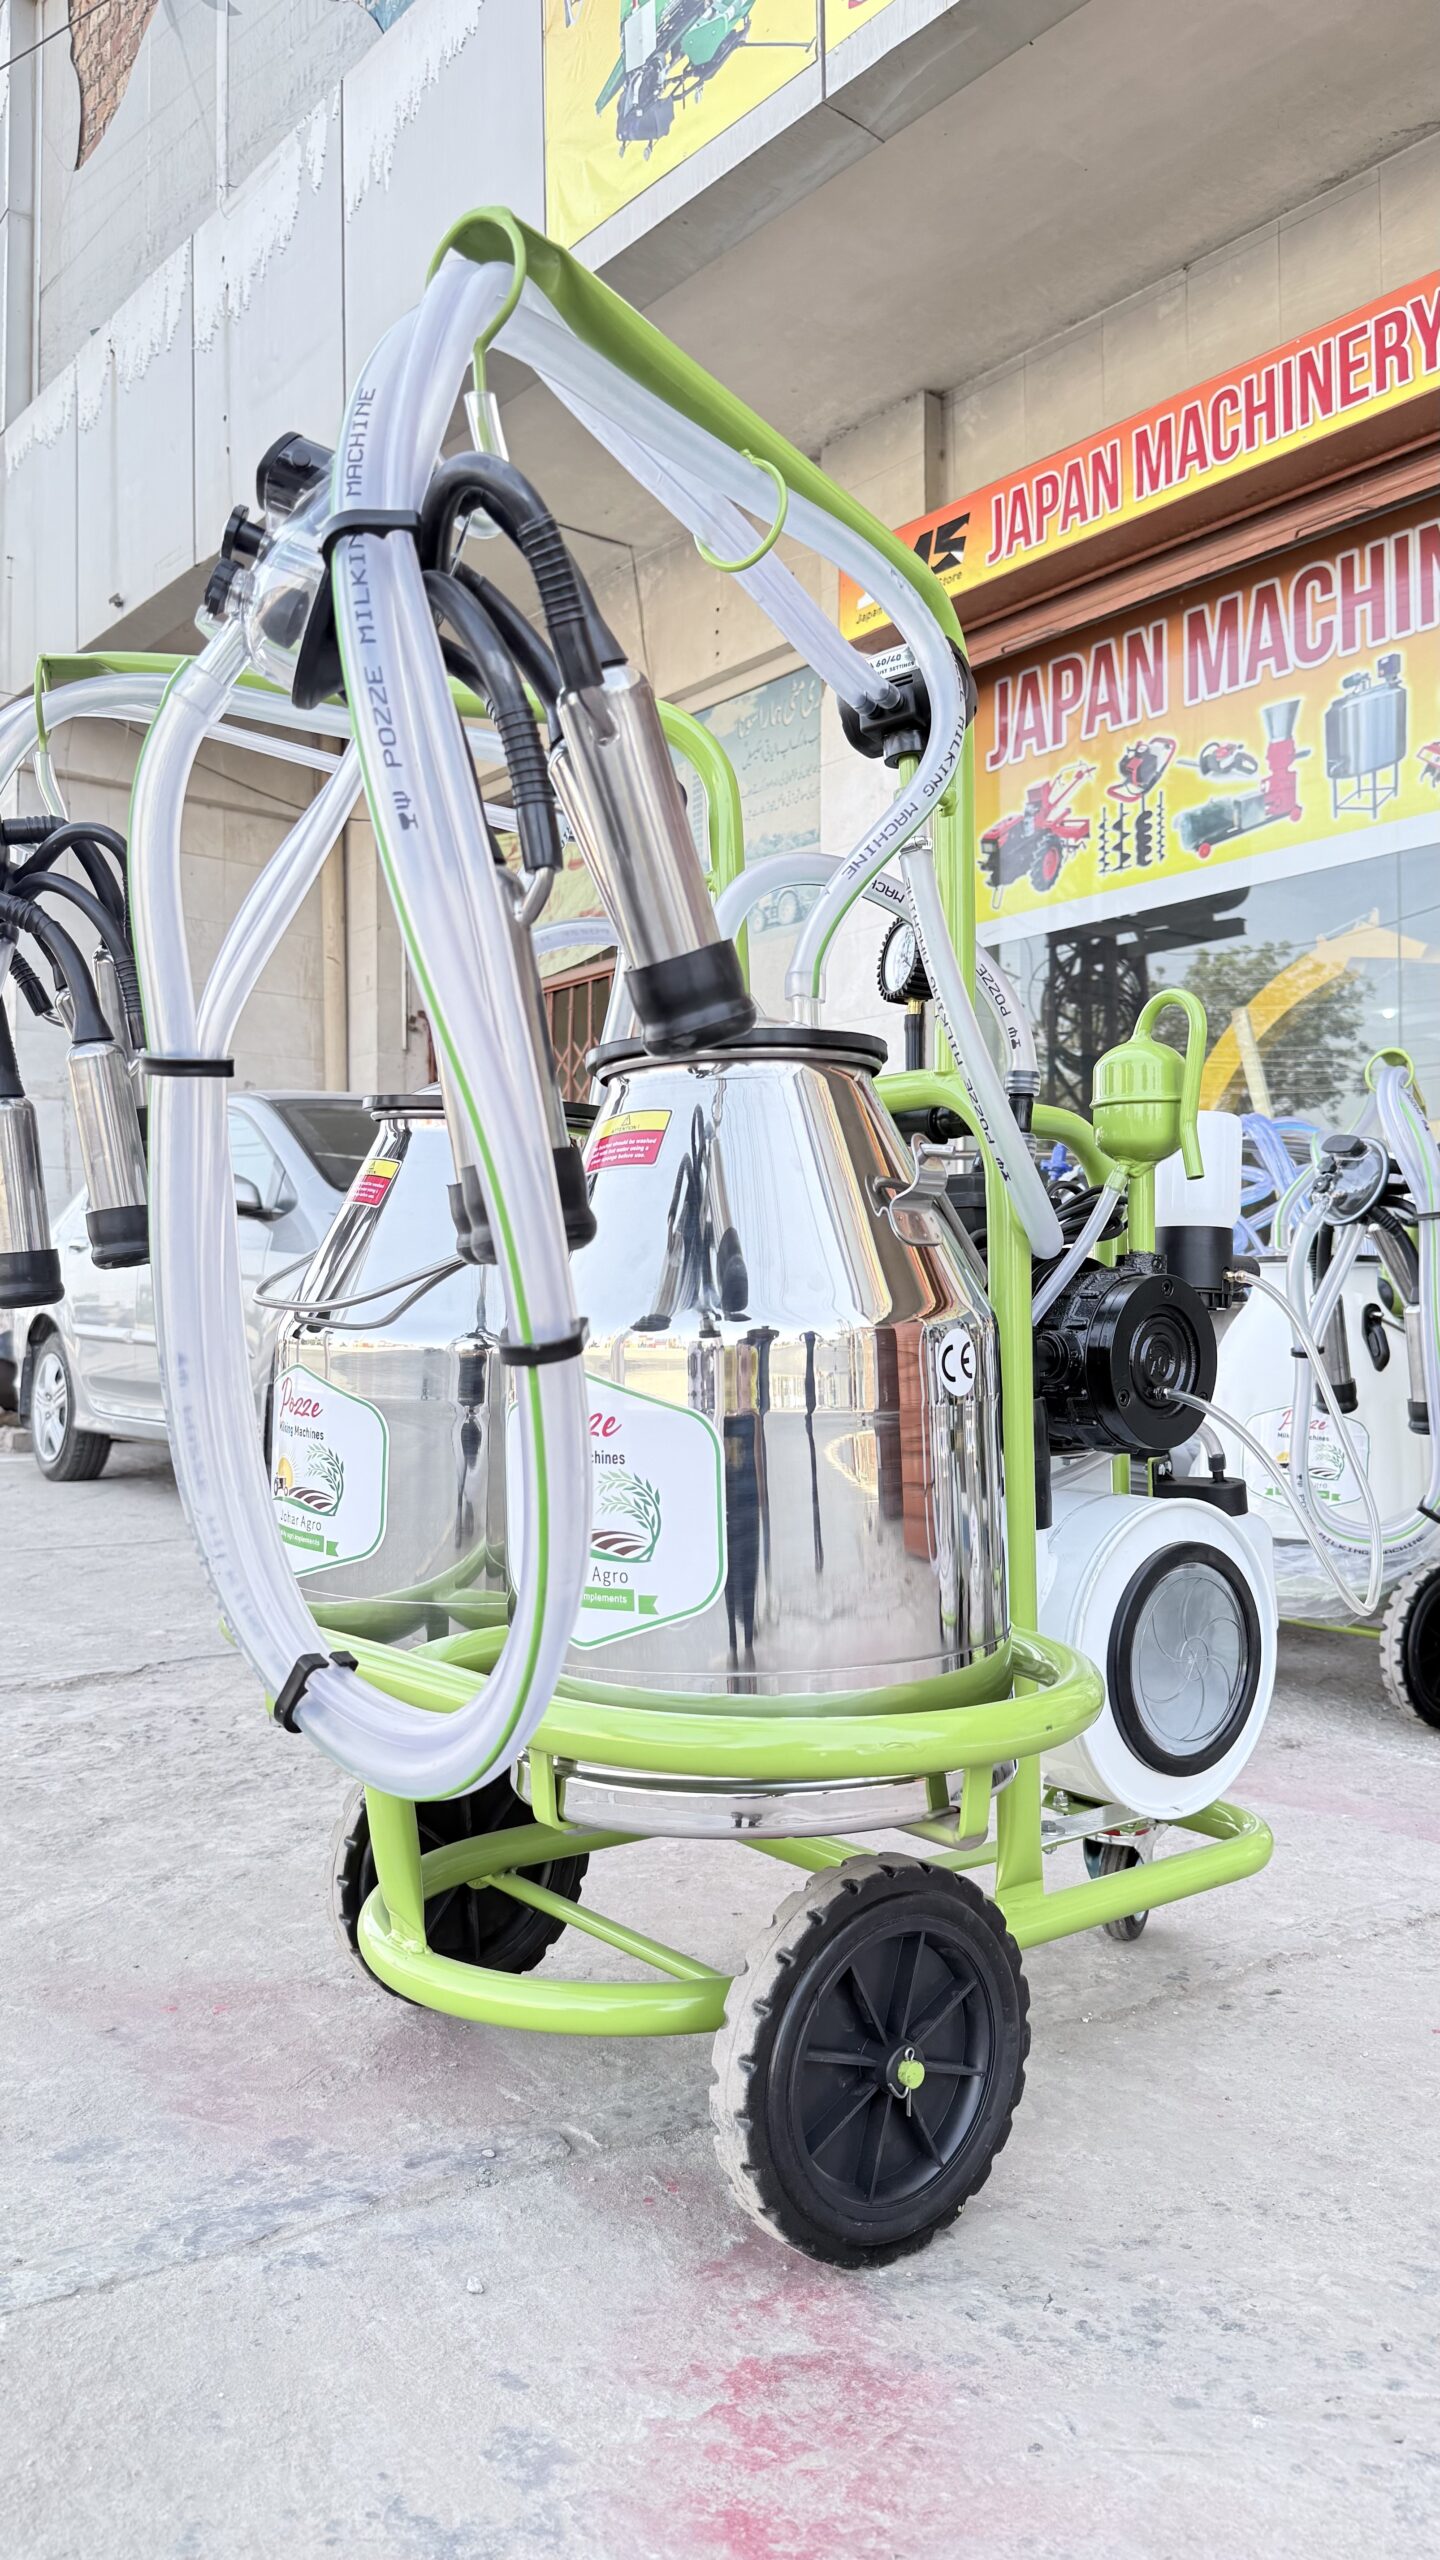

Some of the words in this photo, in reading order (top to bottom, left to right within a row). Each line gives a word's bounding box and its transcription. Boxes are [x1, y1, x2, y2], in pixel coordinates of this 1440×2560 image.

[346, 387, 376, 497] MACHINE
[987, 440, 1121, 564] JAPAN
[1133, 293, 1440, 501] MACHINERY
[347, 534, 377, 645] MILKIN
[876, 653, 902, 668] 60/40
[364, 665, 403, 769] POZZE
[986, 617, 1168, 773] JAPAN
[922, 715, 966, 798] MILKING
[841, 801, 920, 881] MACHINE
[871, 878, 905, 904] MACH
[975, 963, 1009, 1018] POZZE
[962, 1078, 995, 1145] POZZE
[280, 1376, 324, 1418] Pozze
[294, 1425, 325, 1441] Machines
[591, 1450, 626, 1466] hines
[300, 1515, 323, 1532] Agro
[1382, 1534, 1426, 1556] ACHINE
[583, 1592, 628, 1605] mplements
[592, 1565, 629, 1587] Agro
